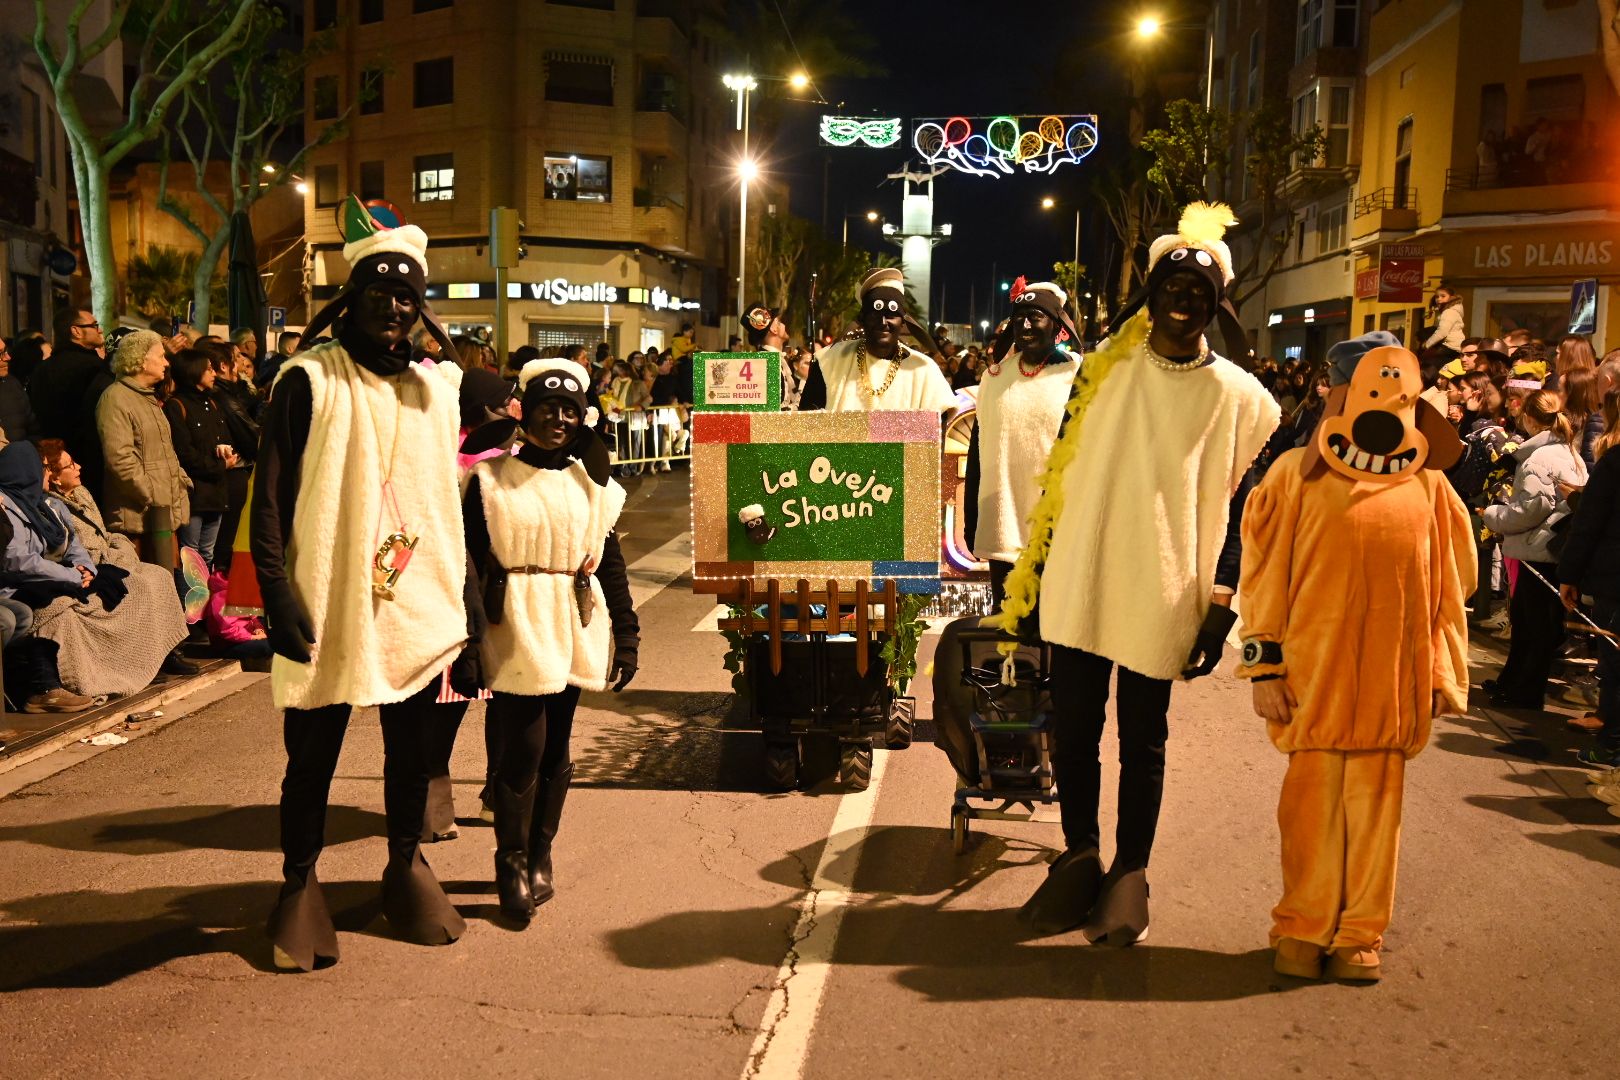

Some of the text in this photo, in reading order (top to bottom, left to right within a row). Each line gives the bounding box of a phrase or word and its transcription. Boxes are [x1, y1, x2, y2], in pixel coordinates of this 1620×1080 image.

[1474, 241, 1612, 268] LAS PLANAS
[273, 310, 283, 324] P
[739, 361, 753, 382] 4
[762, 456, 893, 504] La Oveja
[781, 496, 873, 528] Shaun
